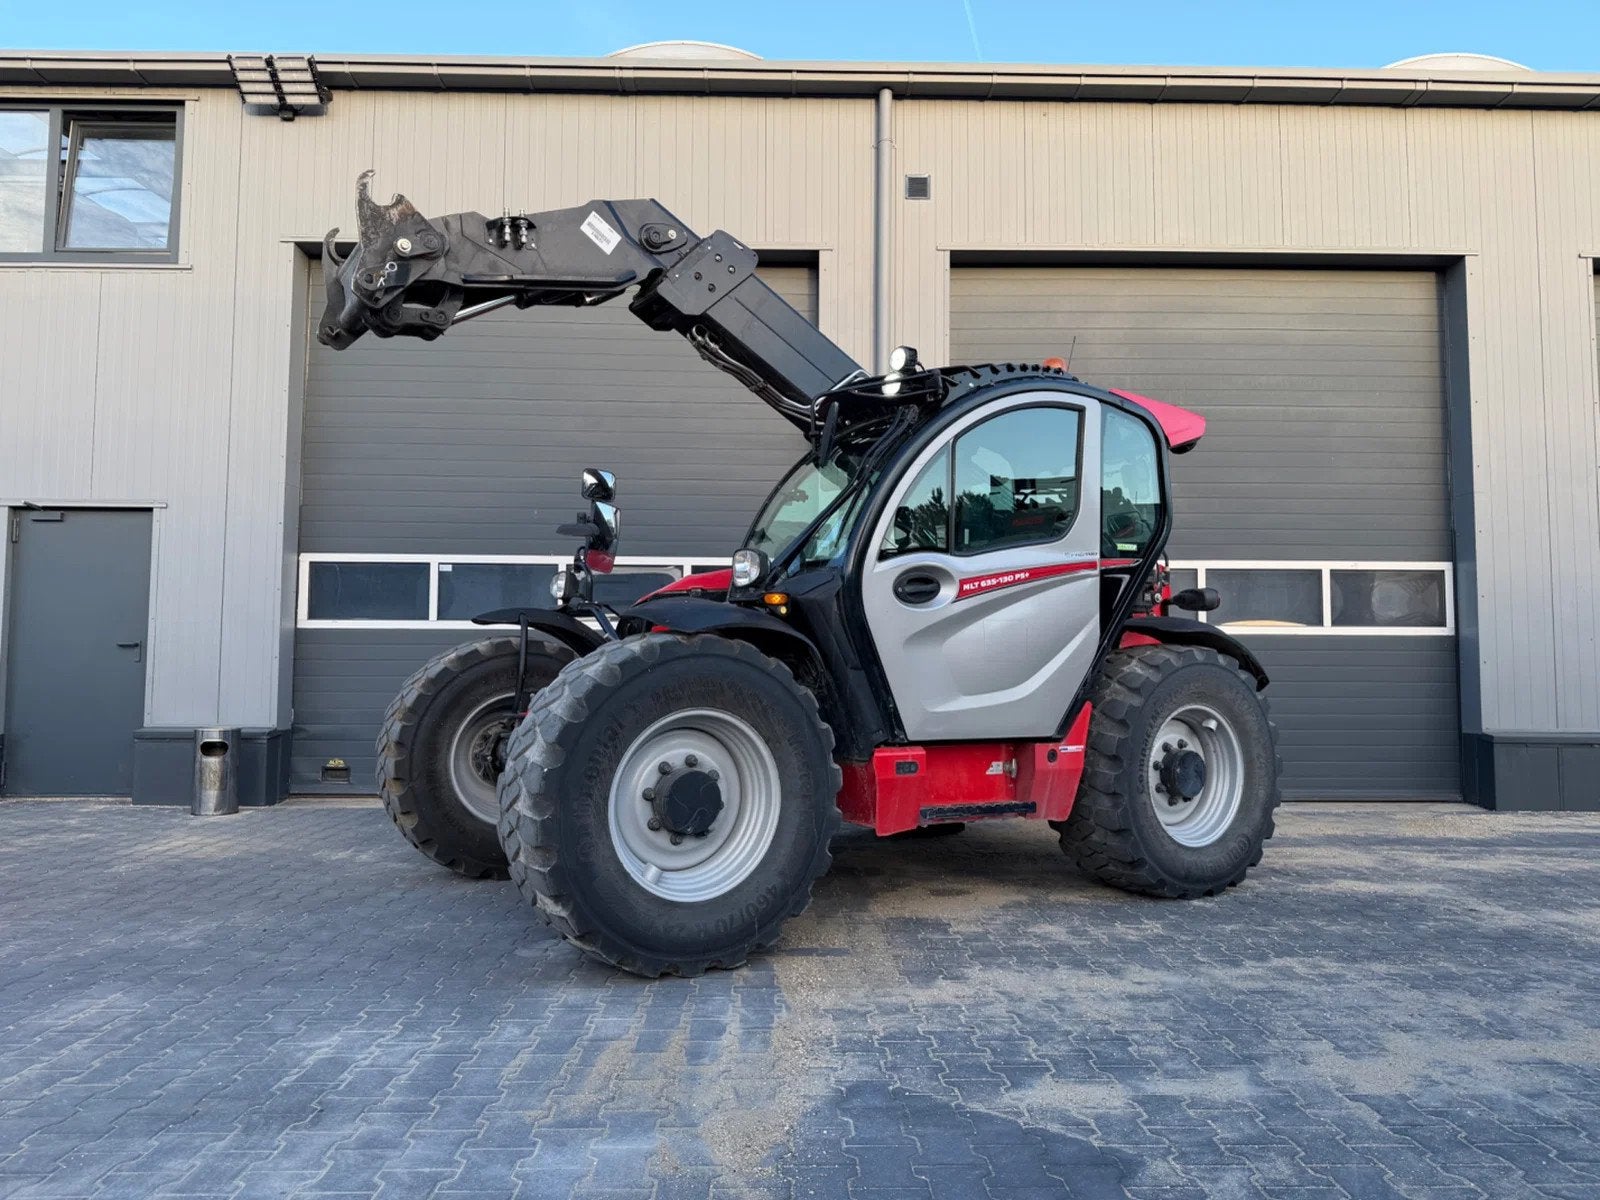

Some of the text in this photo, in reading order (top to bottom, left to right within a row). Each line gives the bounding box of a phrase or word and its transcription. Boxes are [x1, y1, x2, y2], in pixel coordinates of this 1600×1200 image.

[963, 572, 1030, 591] MLT 635-130 PS+
[713, 884, 777, 935] 460/70
